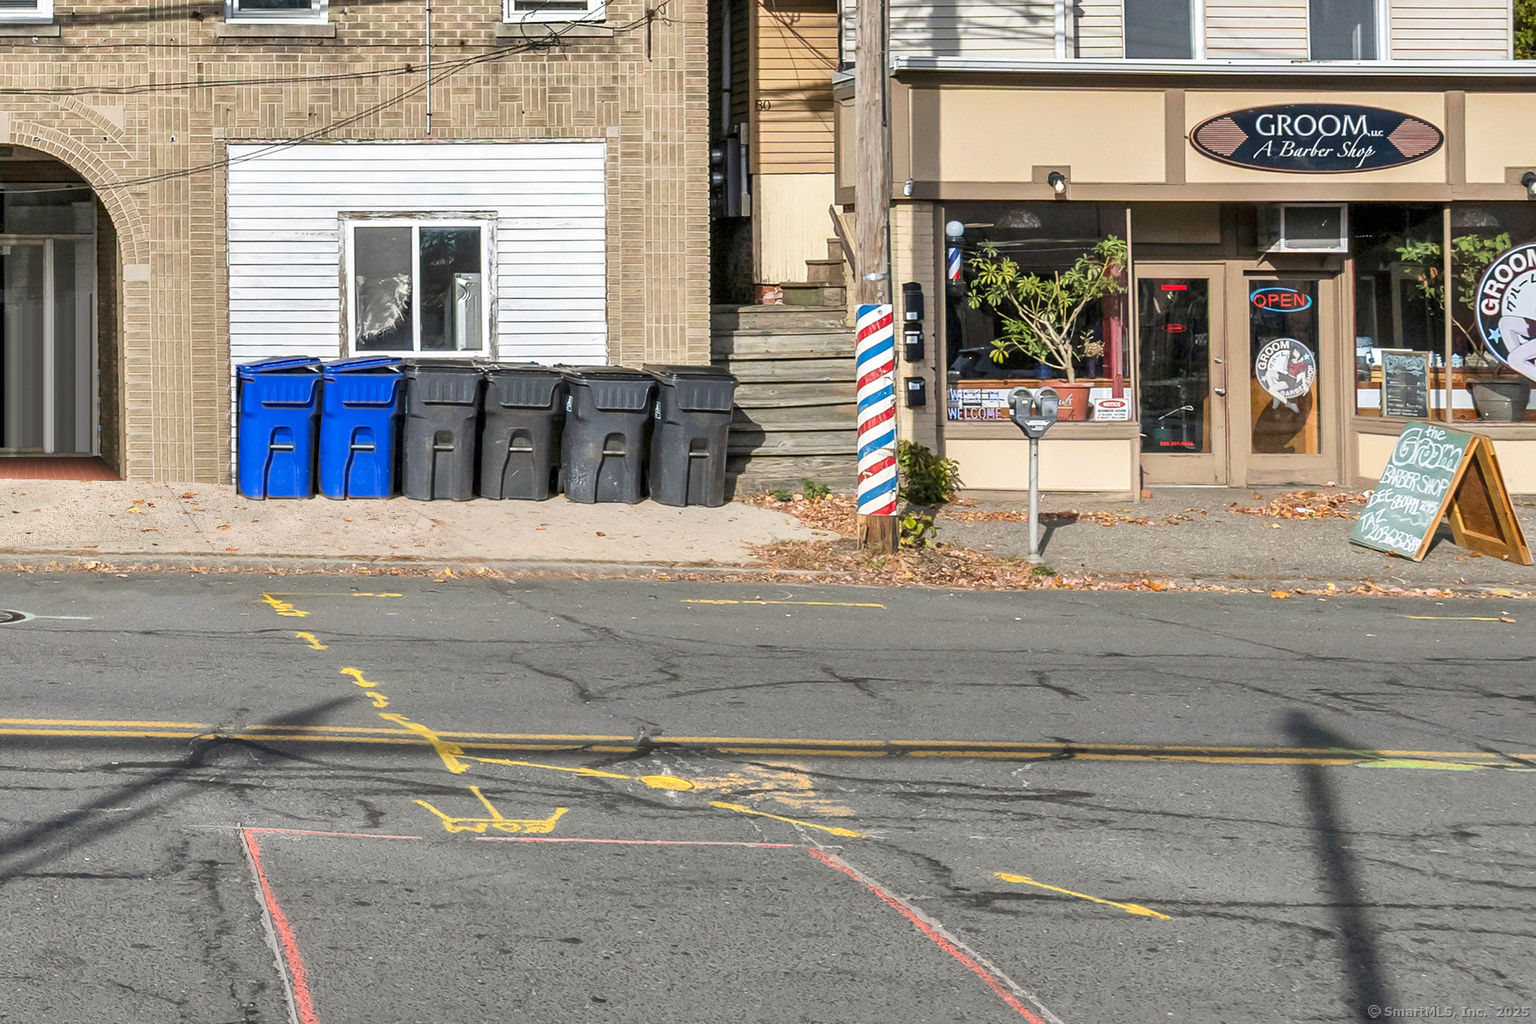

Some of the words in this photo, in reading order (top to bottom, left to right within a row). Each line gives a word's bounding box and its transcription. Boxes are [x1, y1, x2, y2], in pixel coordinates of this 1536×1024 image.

[755, 100, 771, 111] 80
[1255, 114, 1370, 137] GROOM
[1253, 140, 1272, 159] A
[1279, 134, 1334, 158] Barber
[1336, 136, 1377, 168] Shop
[1253, 293, 1306, 308] OPEN
[1259, 341, 1290, 370] GROOM
[948, 407, 1002, 419] WELCOME
[1425, 425, 1447, 440] the
[1379, 464, 1421, 492] BARBER
[1416, 475, 1449, 497] SHOP
[1366, 488, 1394, 508] DEE
[1360, 508, 1388, 532] TAZ
